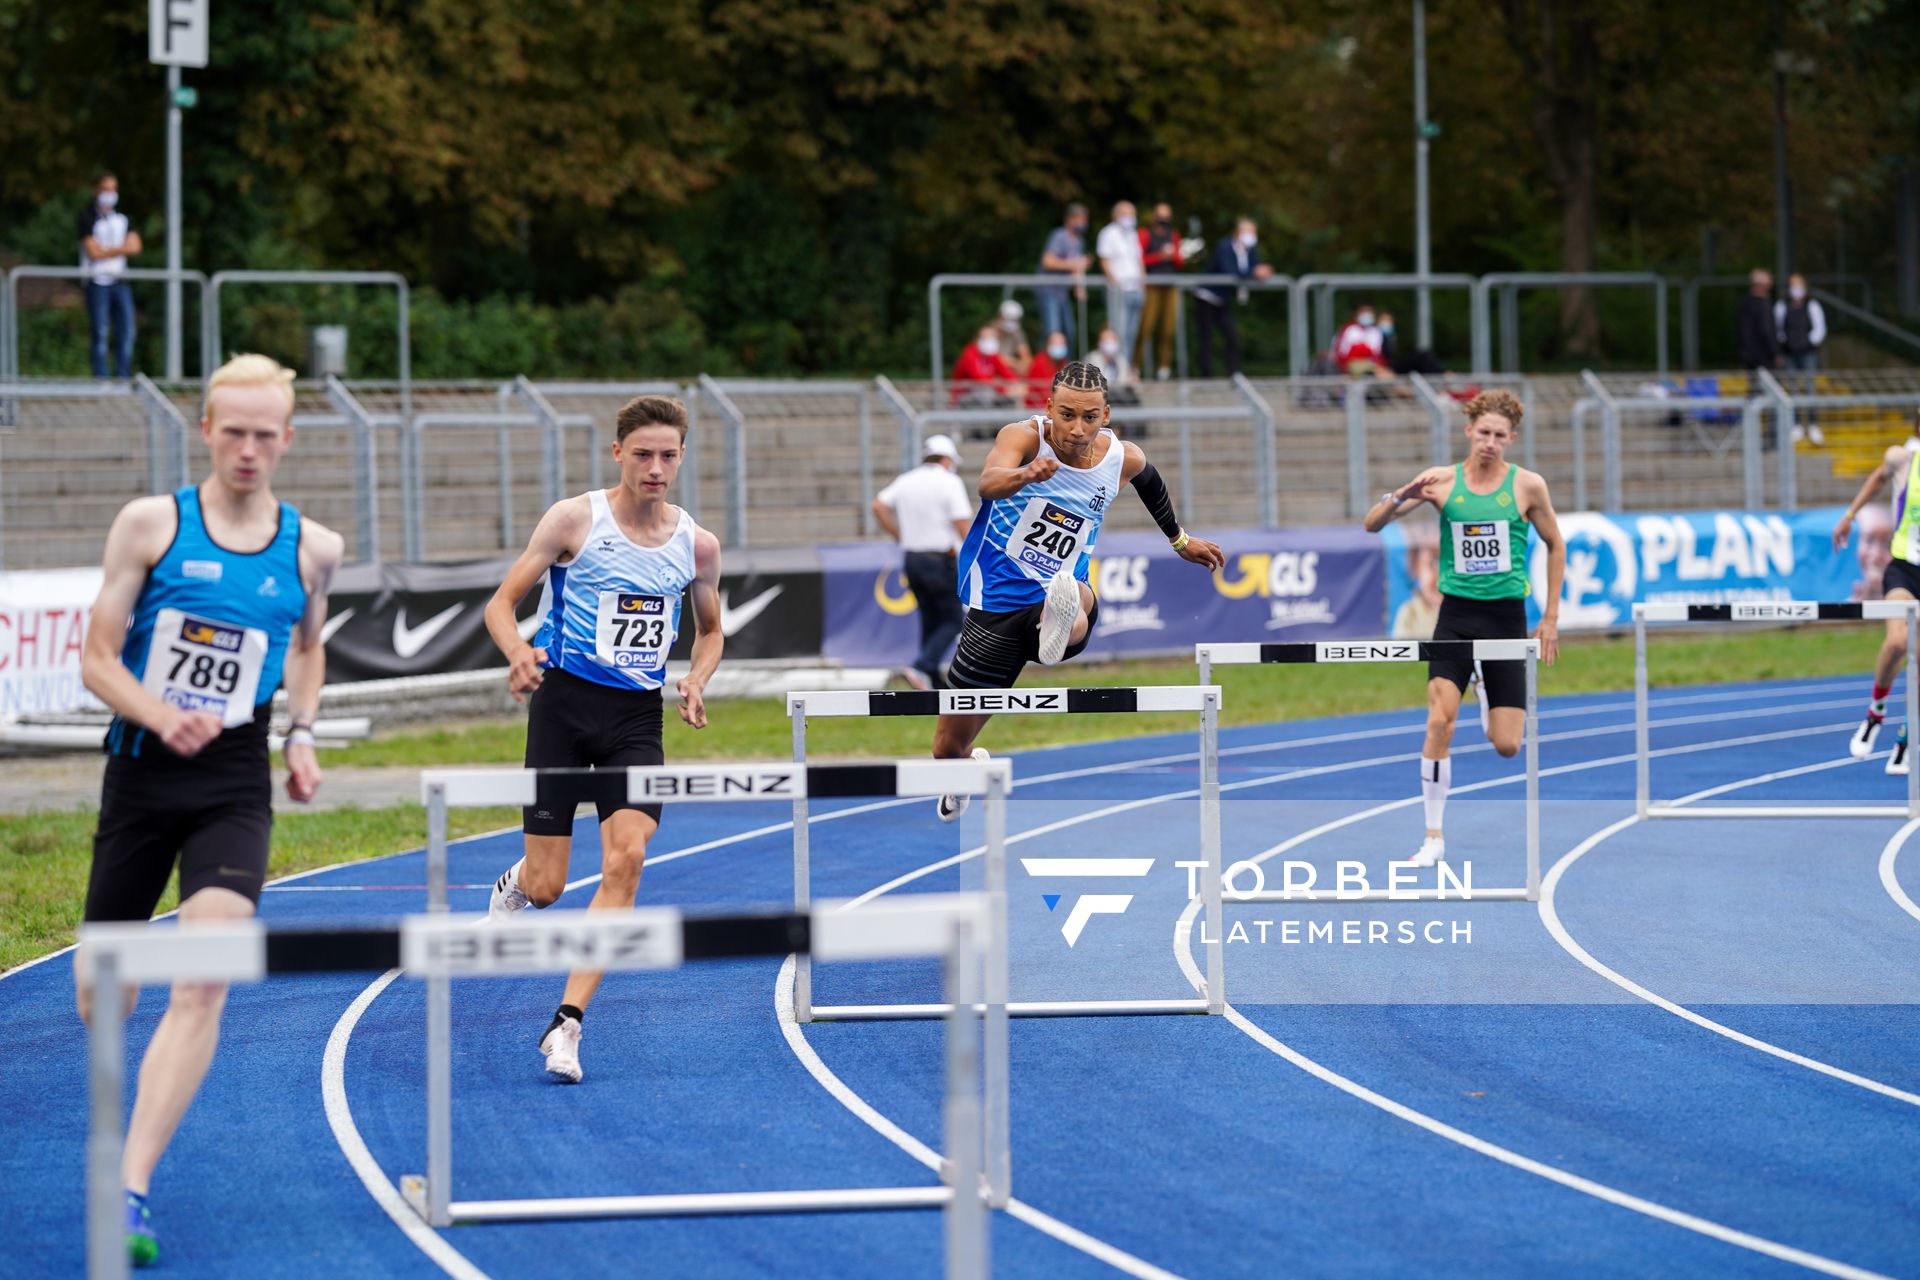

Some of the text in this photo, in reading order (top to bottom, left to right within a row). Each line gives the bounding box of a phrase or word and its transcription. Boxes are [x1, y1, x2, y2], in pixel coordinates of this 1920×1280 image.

[164, 0, 193, 53] F
[1062, 517, 1080, 530] GLS
[1023, 521, 1076, 560] 240
[1462, 539, 1500, 558] 808
[1636, 512, 1795, 581] PLAN
[1037, 555, 1061, 571] PLAN
[1269, 551, 1319, 598] GLS
[1100, 555, 1150, 602] GLS
[642, 600, 662, 611] GLS
[1738, 605, 1811, 617] BENZ
[0, 606, 93, 672] CHTA
[611, 618, 665, 649] 723
[633, 654, 657, 663] PLAN
[1325, 646, 1411, 659] BENZ
[167, 646, 241, 695] 789
[950, 694, 1059, 710] BENZ
[643, 774, 793, 797] BENZ
[426, 926, 650, 960] BENZ
